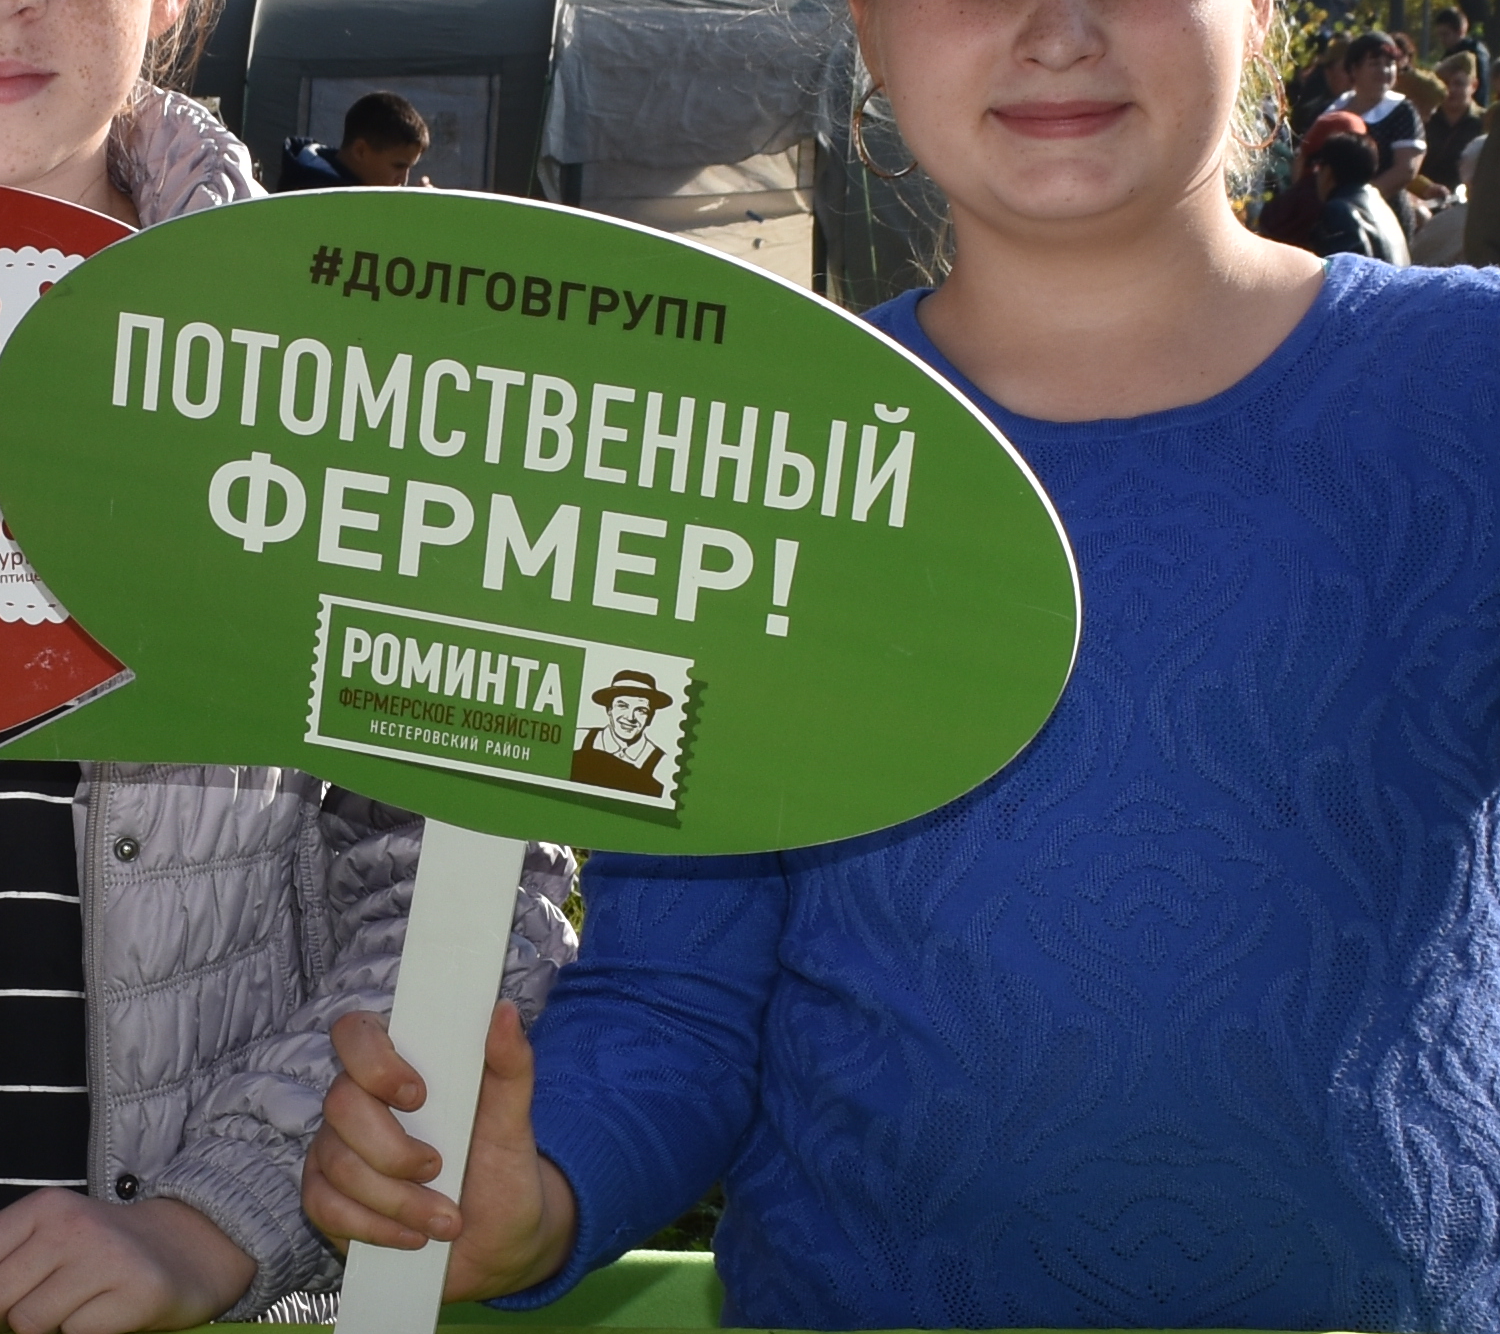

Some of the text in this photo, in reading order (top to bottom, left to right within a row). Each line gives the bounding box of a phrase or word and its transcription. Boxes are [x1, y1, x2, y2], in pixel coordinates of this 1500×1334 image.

[310, 243, 729, 347] #ДОЛГОВГРУПП
[111, 311, 919, 530] ПОТОМСТВЕННЫЙ
[206, 449, 801, 639] ФЕРМЕР!
[338, 687, 563, 746] ФЕРМЕРСКОЕ ХОЗЯЙСТВО
[340, 626, 565, 717] РОМИНТА
[369, 718, 532, 762] НЕСТЕРОВСКИЙ РАЙОН
